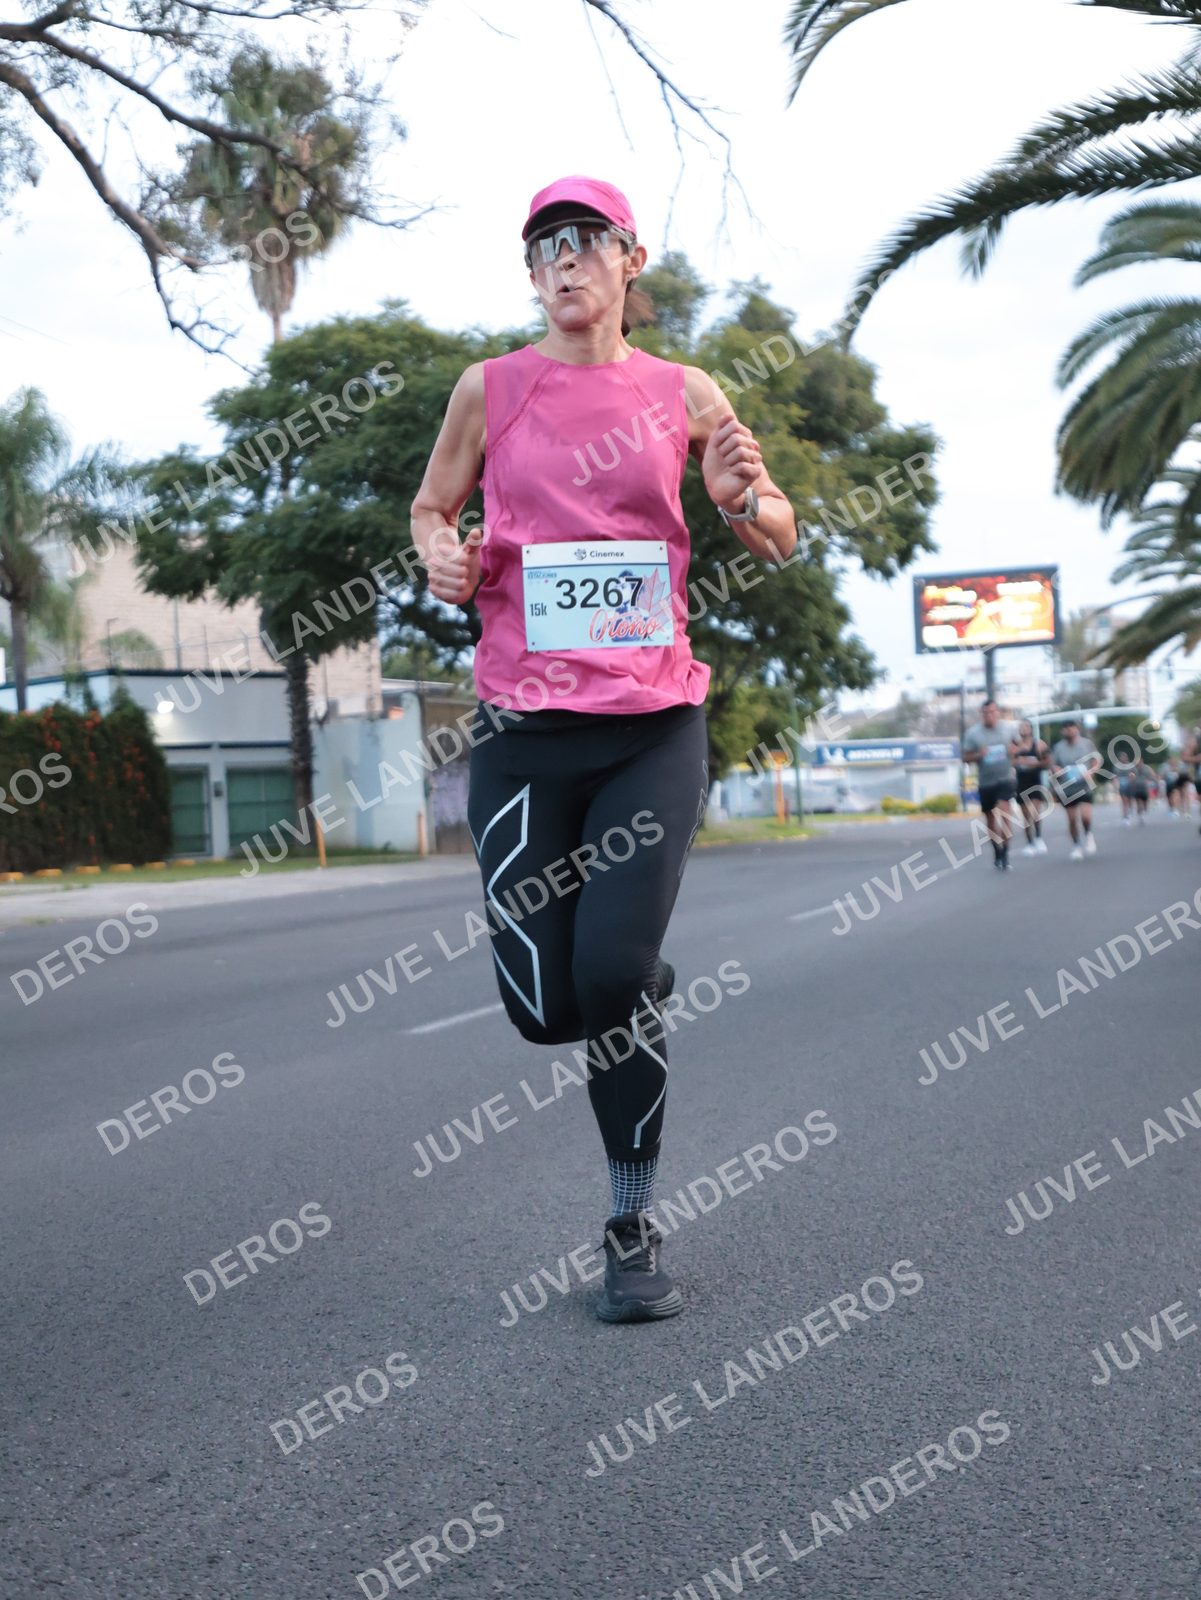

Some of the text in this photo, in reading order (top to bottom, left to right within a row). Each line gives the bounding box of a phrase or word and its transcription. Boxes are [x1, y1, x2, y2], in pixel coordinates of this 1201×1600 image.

[589, 550, 625, 558] Cinemex
[555, 577, 643, 610] 3267
[530, 602, 547, 617] 15k
